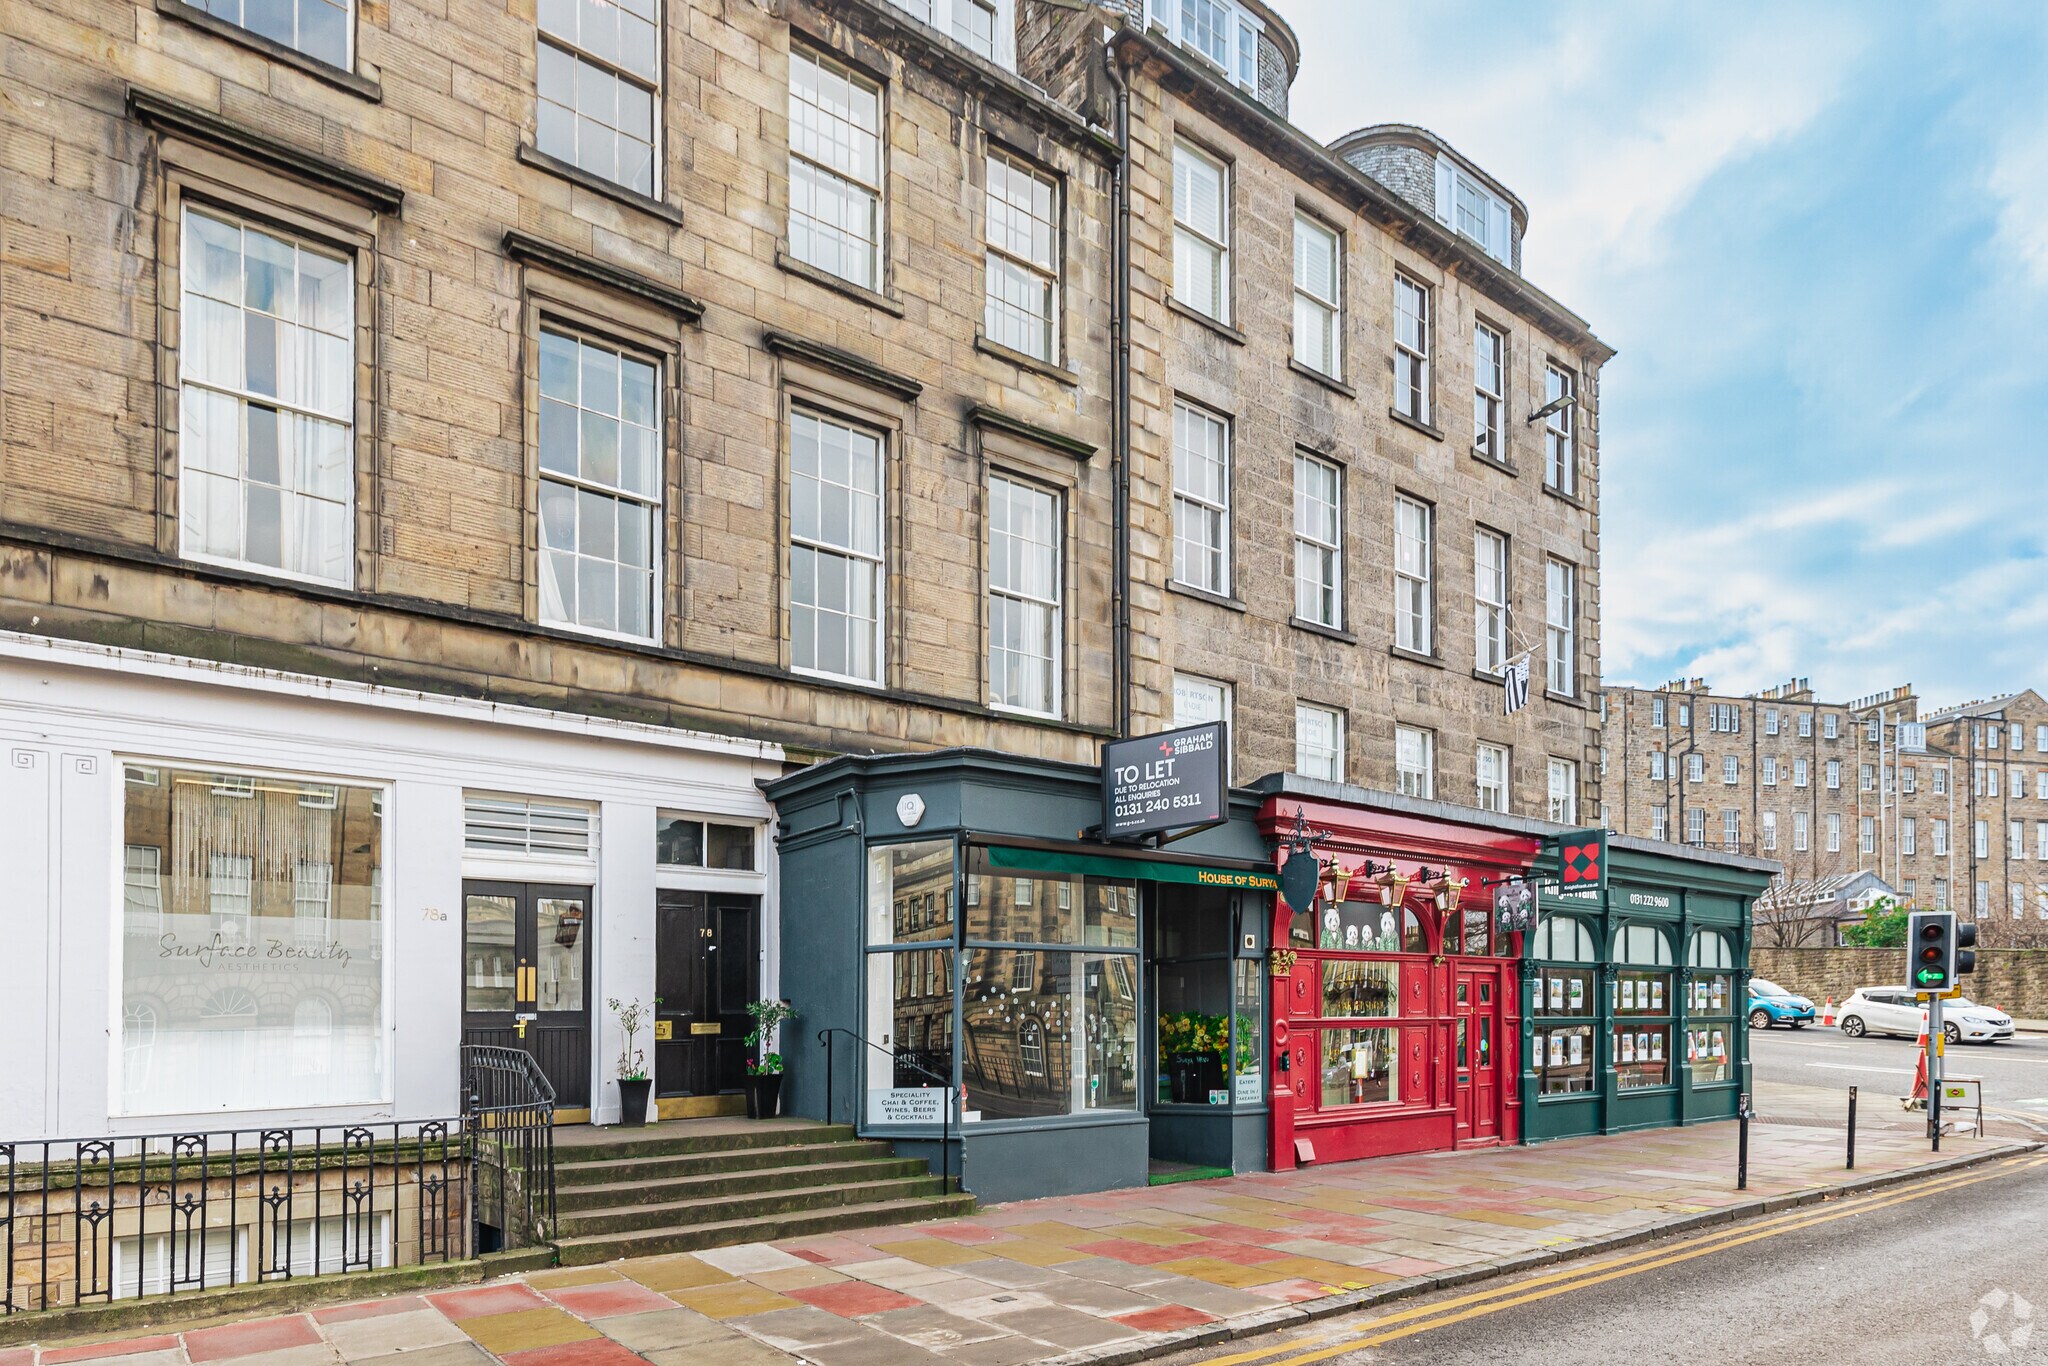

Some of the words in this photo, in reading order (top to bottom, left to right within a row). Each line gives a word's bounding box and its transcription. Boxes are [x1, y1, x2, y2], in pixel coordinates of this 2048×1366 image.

[1174, 732, 1213, 747] GRAHAM
[1174, 741, 1213, 755] SIBBALD
[1115, 765, 1139, 785] TO
[1145, 758, 1175, 780] LET
[1115, 786, 1127, 795] DUE
[1128, 785, 1138, 793] TO
[1138, 777, 1180, 791] RELOCATION
[1115, 796, 1126, 804] ALL
[1128, 789, 1161, 801] ENQUIRIES
[1115, 802, 1142, 817] 0131
[1145, 798, 1170, 813] 240
[1173, 793, 1202, 808] 5311
[1198, 871, 1234, 885] HOUSE
[1234, 875, 1248, 886] OF
[1248, 875, 1279, 889] SURYA
[1629, 893, 1643, 905] 0131
[1643, 894, 1654, 906] 222
[1654, 896, 1669, 908] 9600
[421, 906, 448, 921] 78a
[699, 928, 713, 938] 78
[159, 932, 258, 968] Surface
[266, 939, 352, 968] Beauty
[218, 963, 299, 972] AESTHETICS
